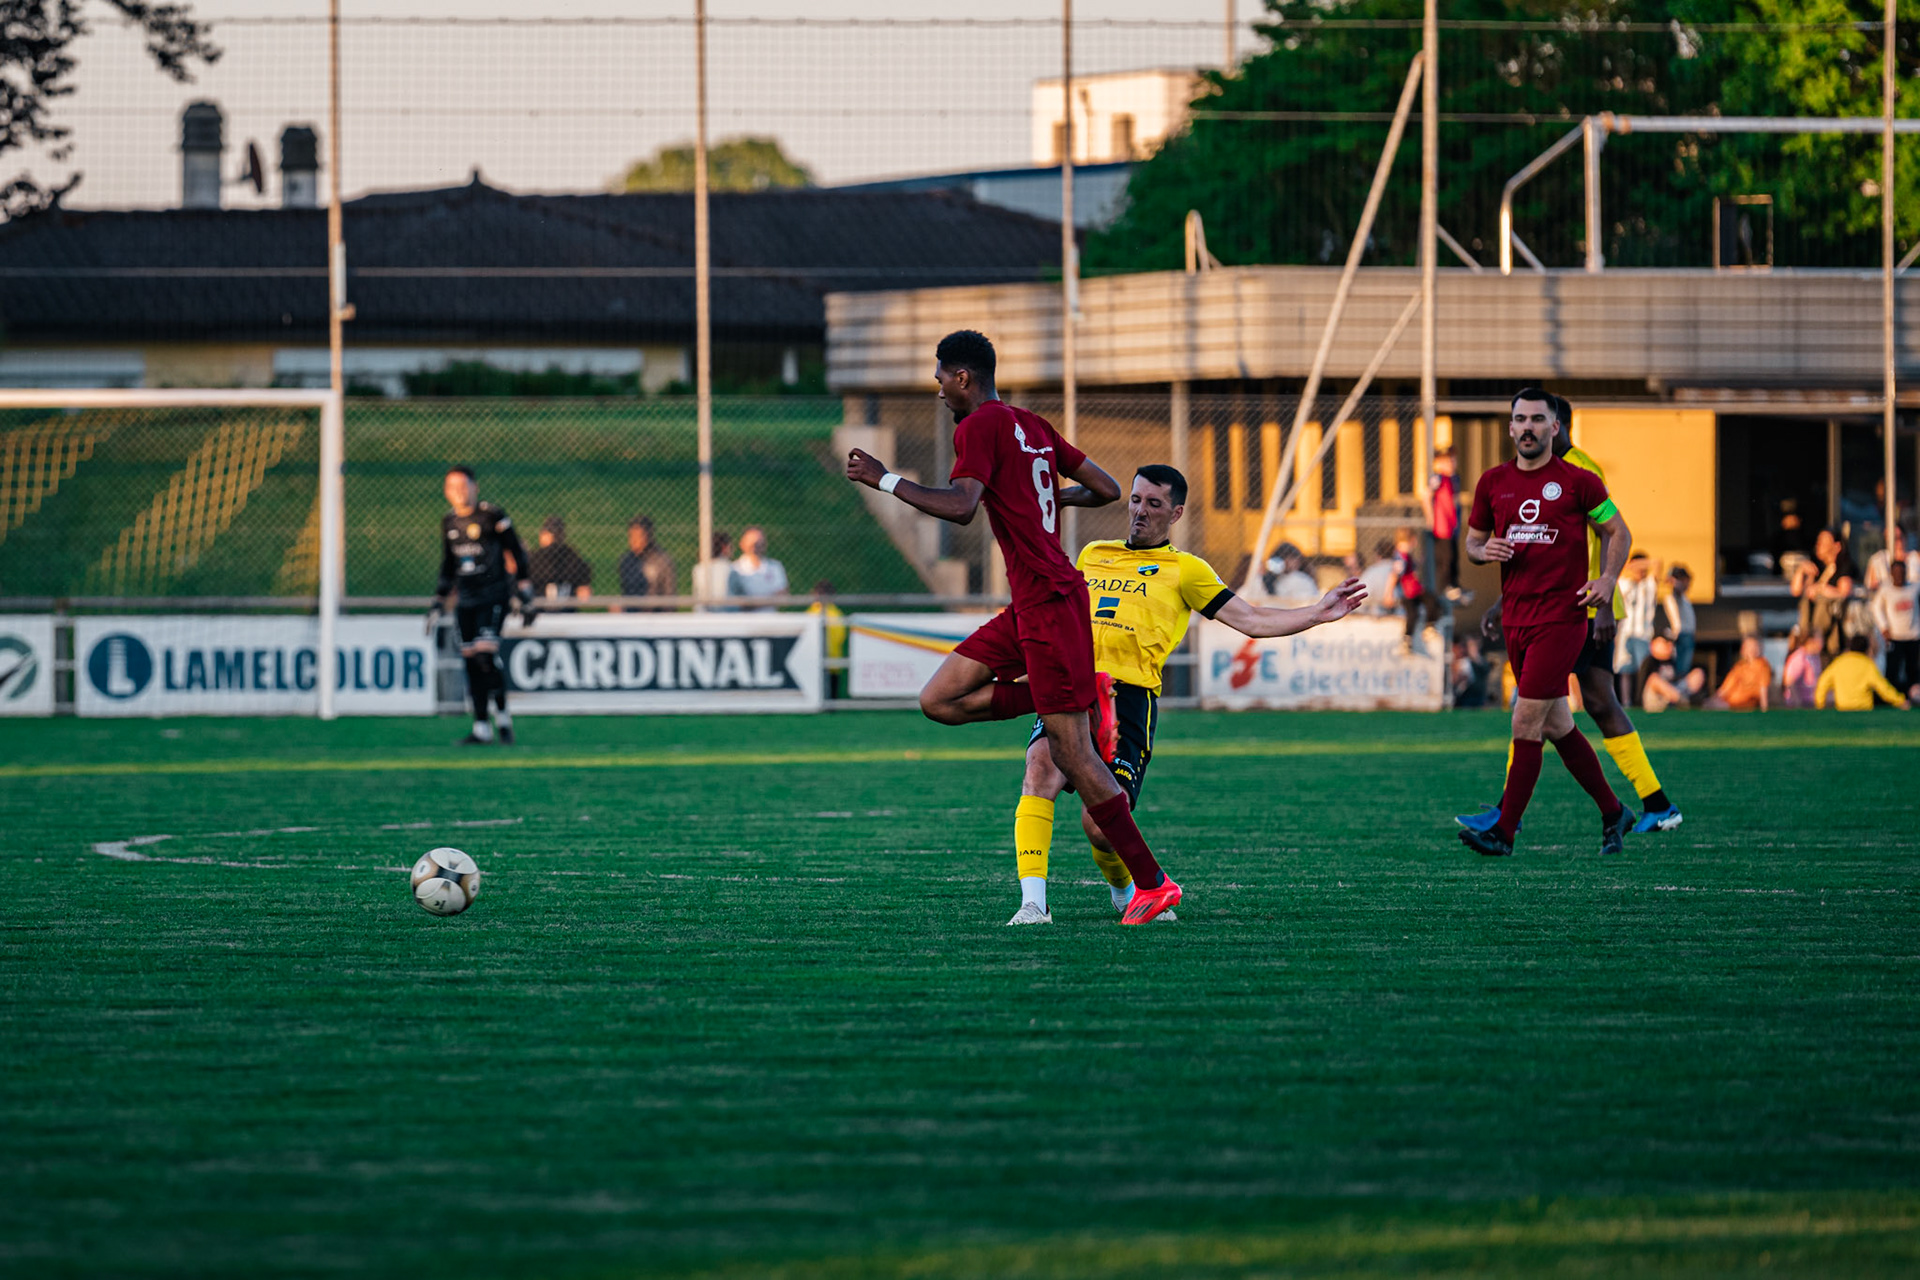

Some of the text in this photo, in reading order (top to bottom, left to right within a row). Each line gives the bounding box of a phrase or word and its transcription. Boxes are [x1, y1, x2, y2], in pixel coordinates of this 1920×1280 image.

[1031, 457, 1056, 534] 8
[508, 638, 786, 691] CARDINAL
[1115, 768, 1132, 780] JAKO
